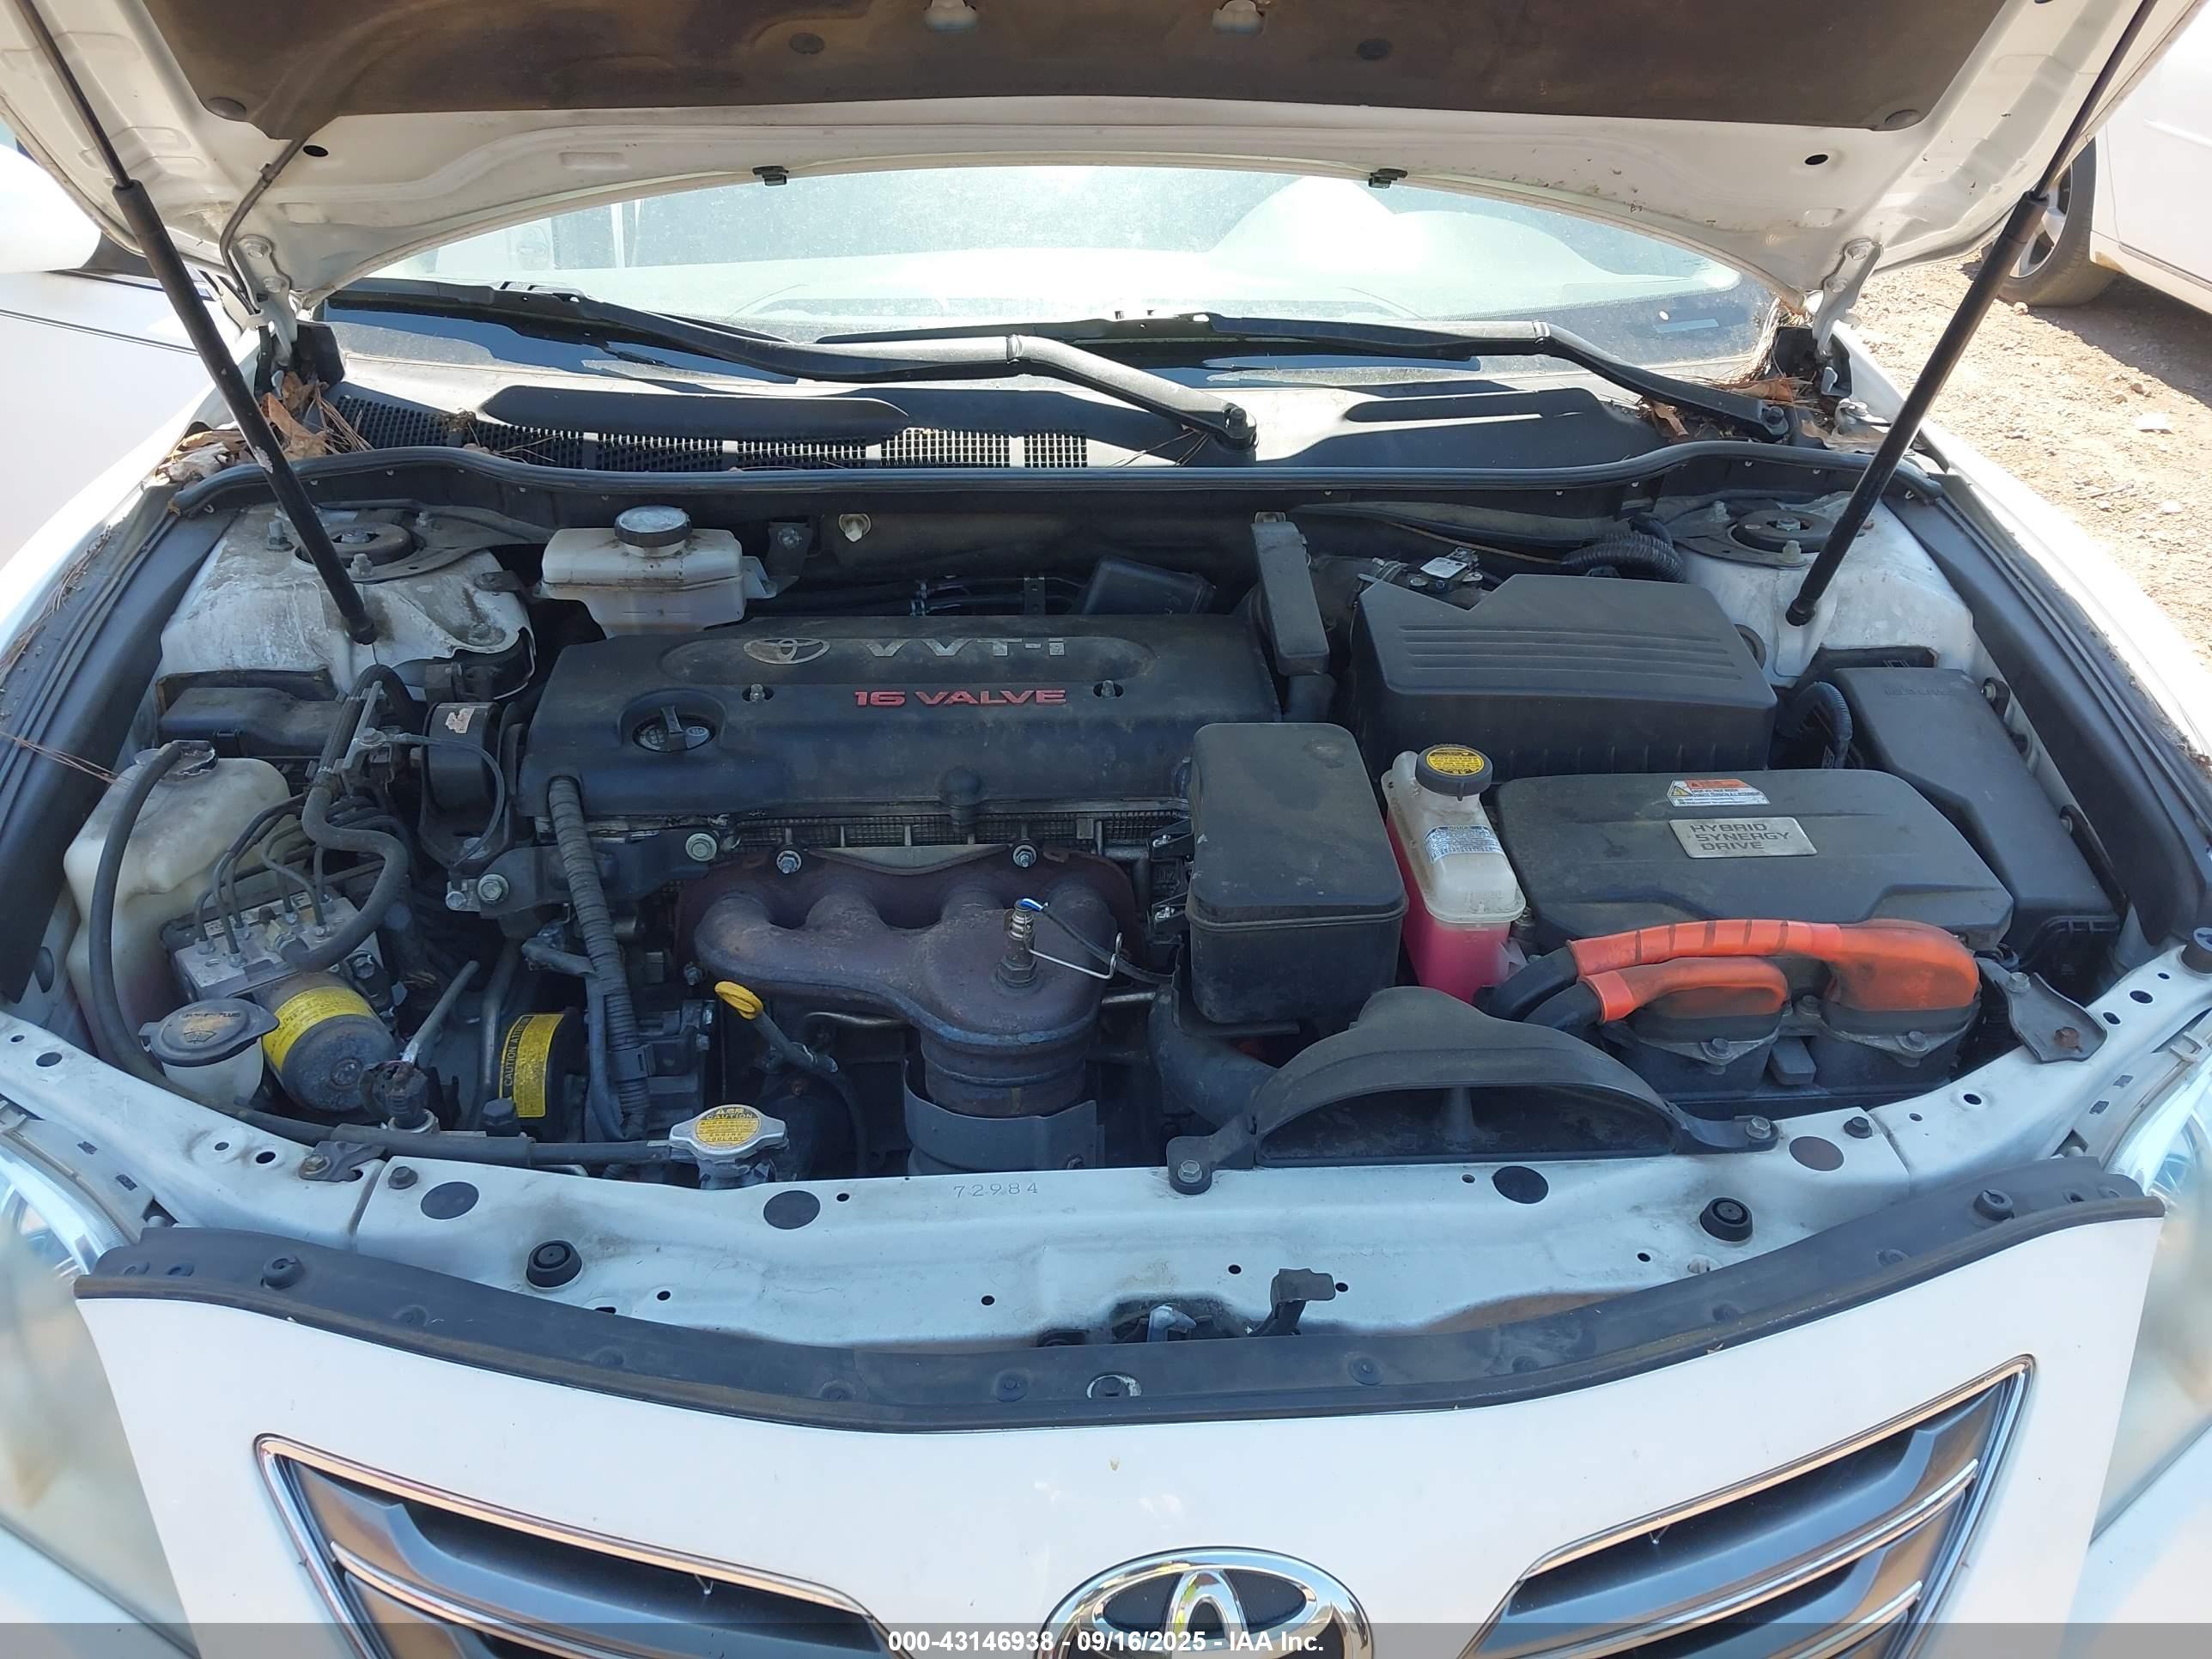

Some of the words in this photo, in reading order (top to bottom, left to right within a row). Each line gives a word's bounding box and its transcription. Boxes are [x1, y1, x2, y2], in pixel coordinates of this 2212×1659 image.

[860, 638, 1066, 657] VVT-i
[854, 690, 906, 707] 16
[914, 689, 1067, 706] VALVE
[1690, 823, 1767, 833] HYBRID
[1695, 832, 1790, 842] SYNERGY
[1701, 842, 1765, 851] DRIVE
[504, 1046, 517, 1086] CAUTION
[953, 1182, 1038, 1198] 72984
